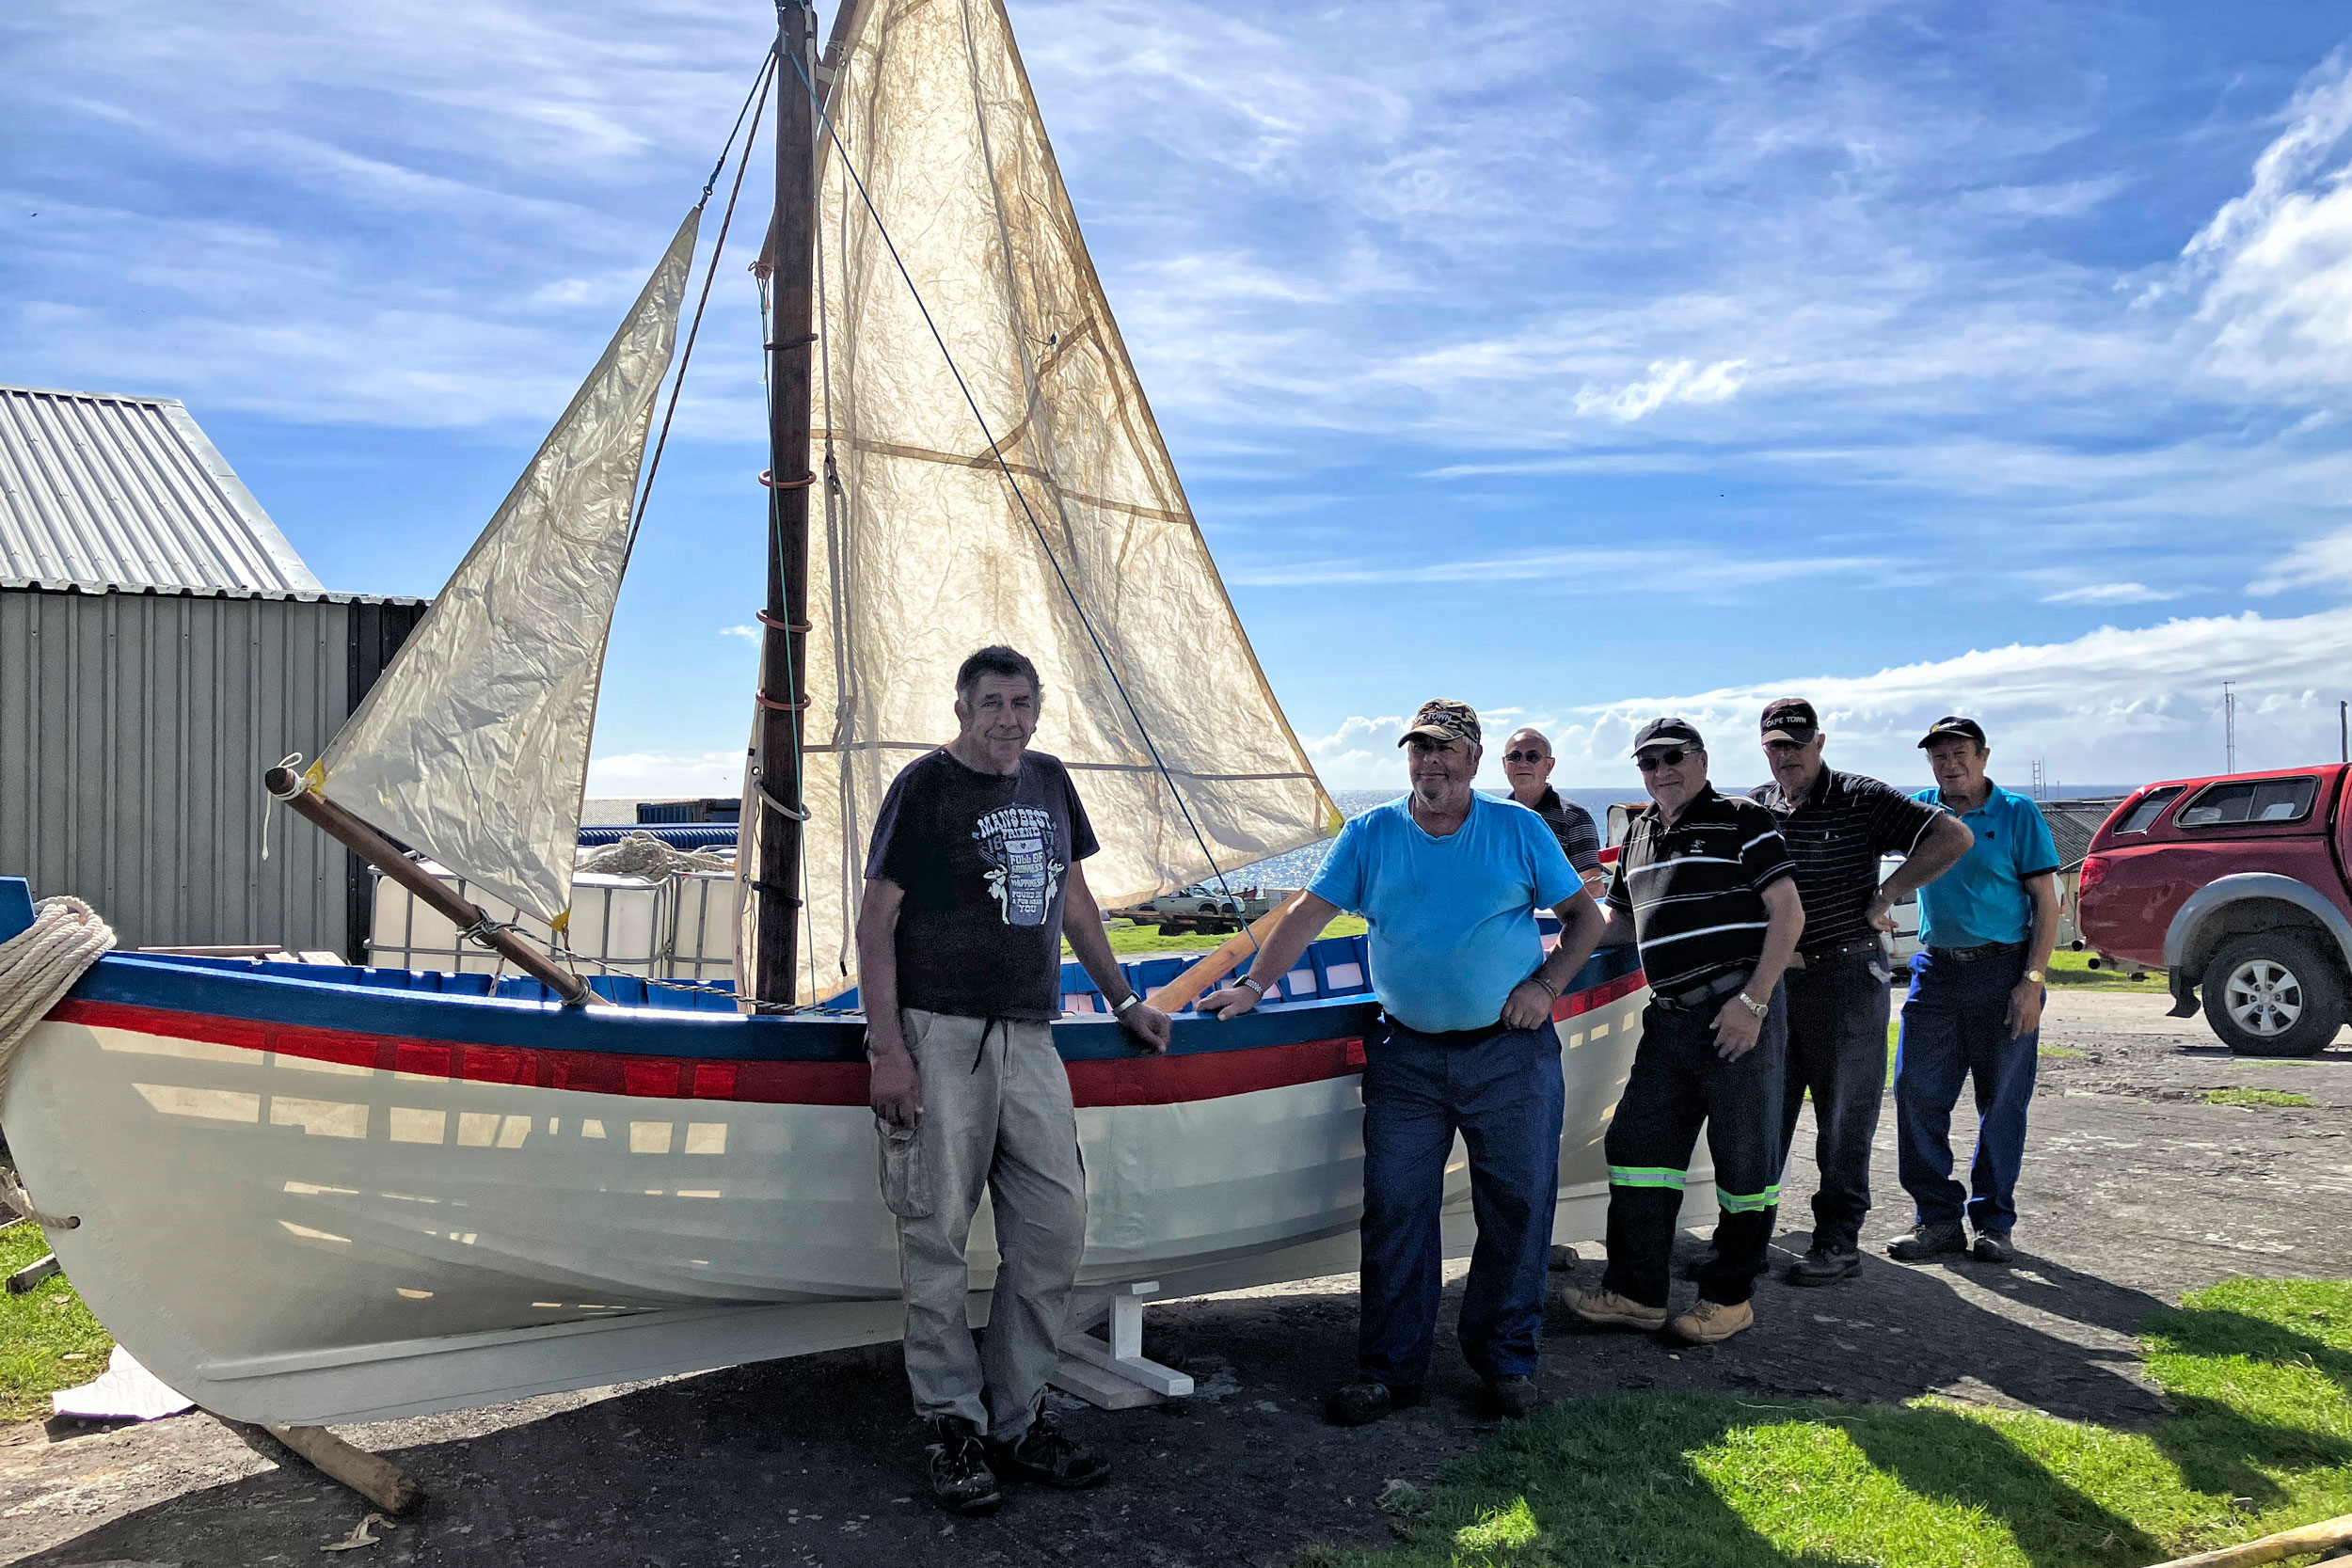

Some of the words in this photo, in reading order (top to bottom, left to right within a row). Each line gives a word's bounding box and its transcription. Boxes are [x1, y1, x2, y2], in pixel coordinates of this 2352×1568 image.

[1427, 713, 1452, 721] TOWN
[1766, 717, 1784, 727] CAPE
[1787, 716, 1806, 724] TOWN
[977, 808, 1019, 838] MANS
[1017, 809, 1052, 830] BEST
[1001, 827, 1041, 840] FRIEND
[1010, 854, 1032, 864] FULL
[1033, 852, 1043, 863] OF
[1011, 863, 1043, 873] GOODNESS
[1011, 879, 1044, 888] HAPPINESS
[1012, 891, 1035, 899] FOUND
[1019, 904, 1037, 913] YOU
